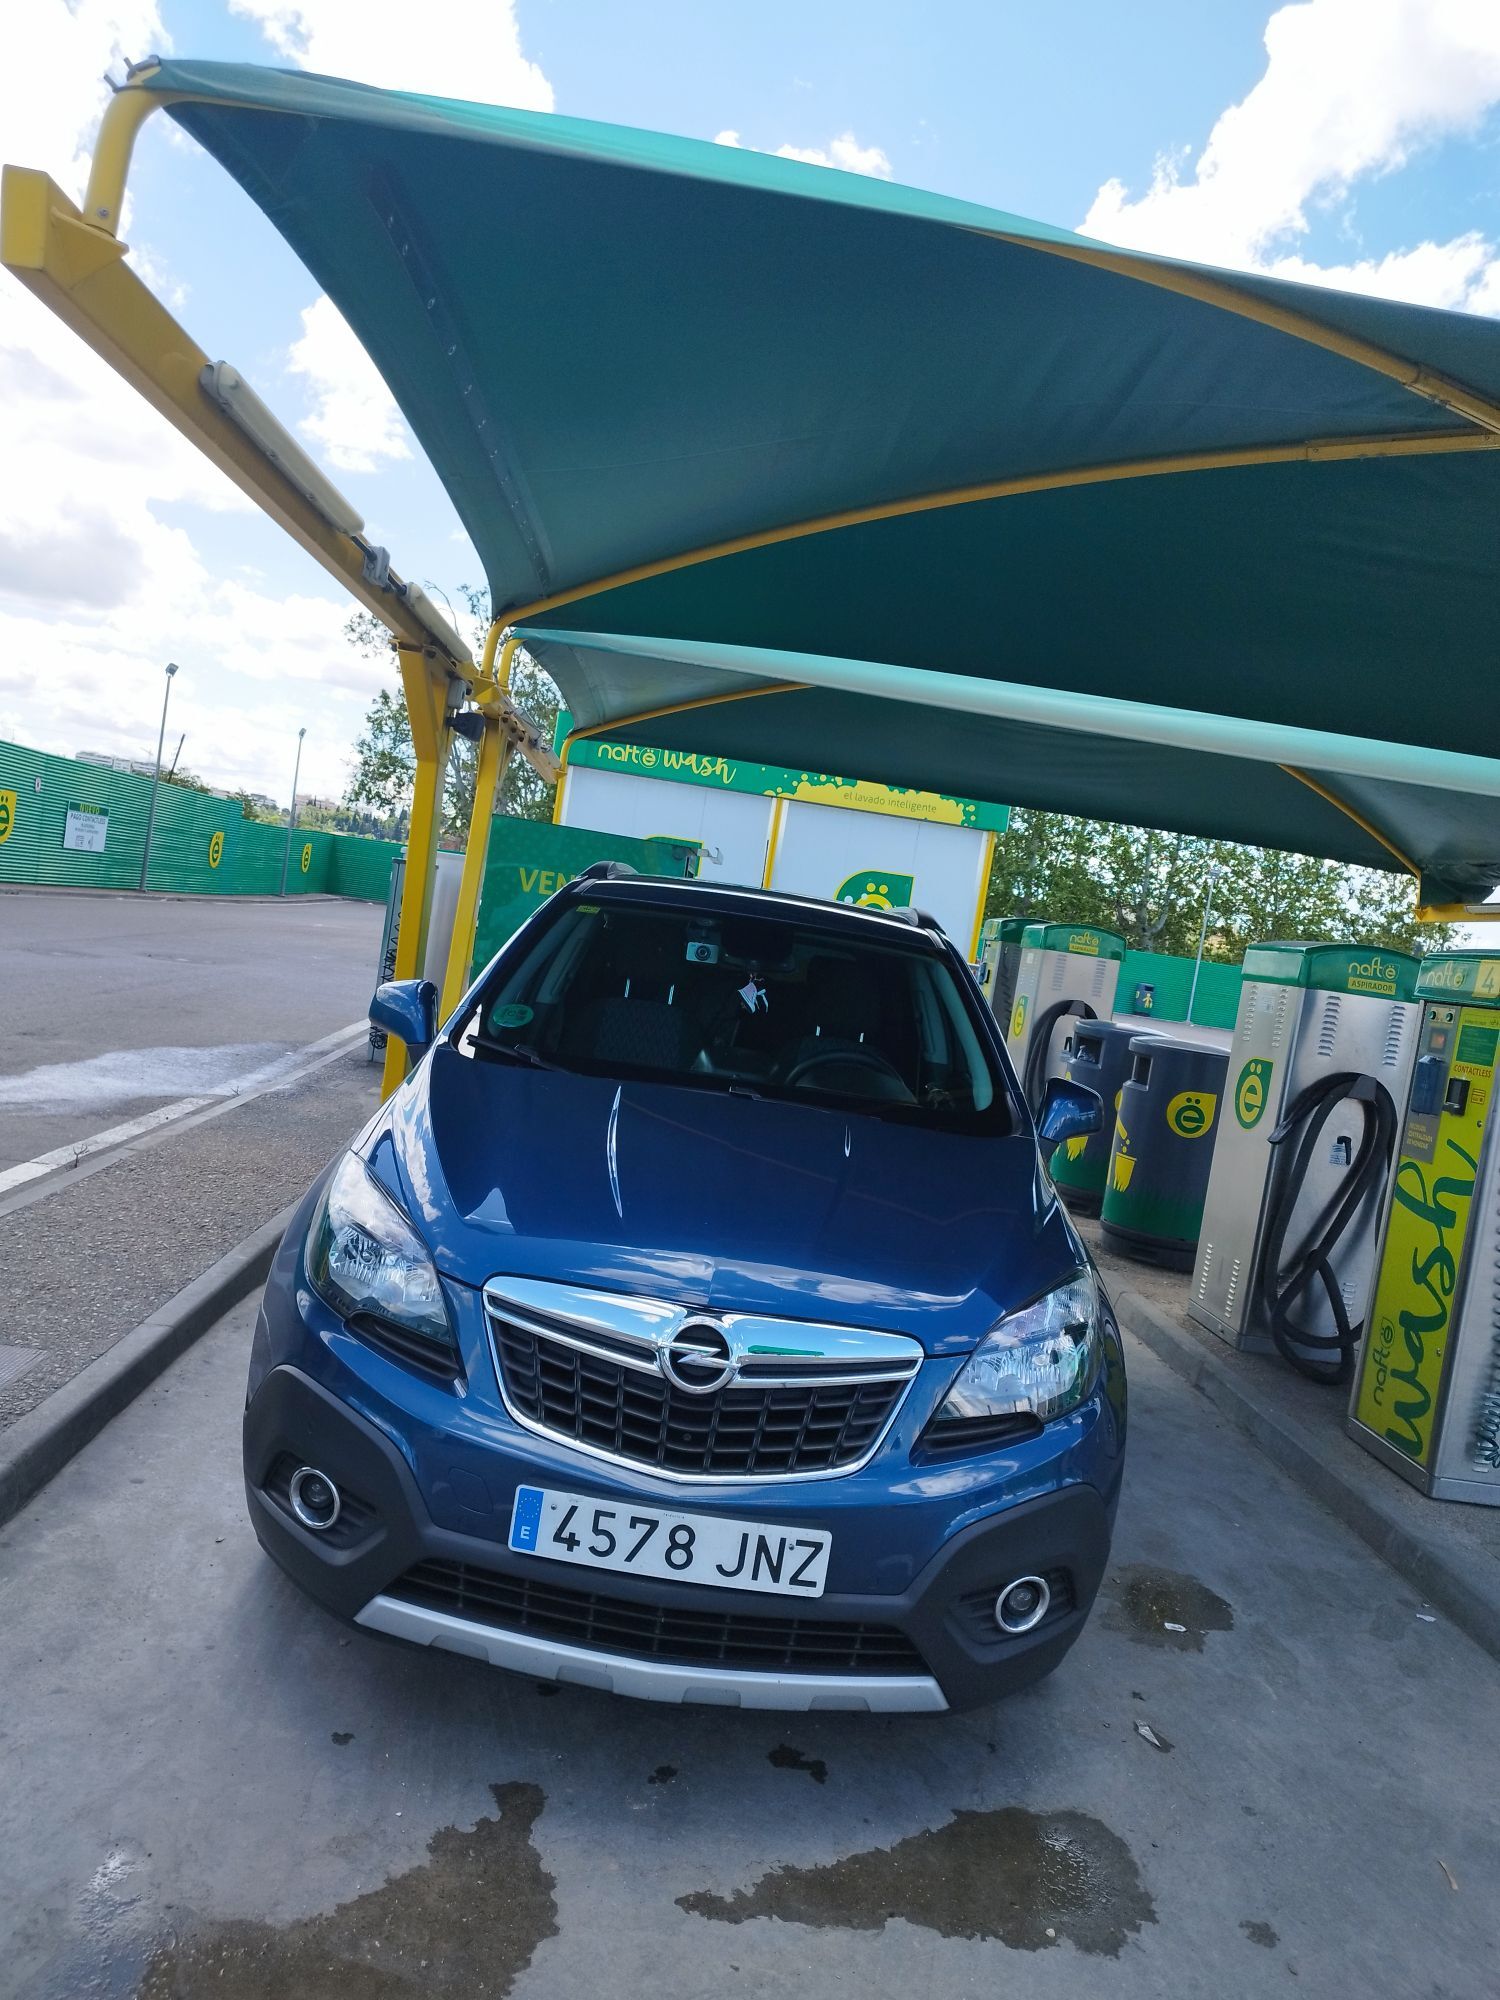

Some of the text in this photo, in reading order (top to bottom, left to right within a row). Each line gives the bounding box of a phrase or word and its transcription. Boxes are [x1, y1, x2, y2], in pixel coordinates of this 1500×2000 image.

[843, 791, 937, 813] el lavado inteligente
[1351, 980, 1393, 992] ASPIRADOR
[1481, 965, 1495, 993] 4
[1454, 1064, 1492, 1079] CONTACTLESS
[1384, 1138, 1479, 1457] wash
[520, 1526, 531, 1540] E
[552, 1505, 824, 1588] 4578 JNZ
